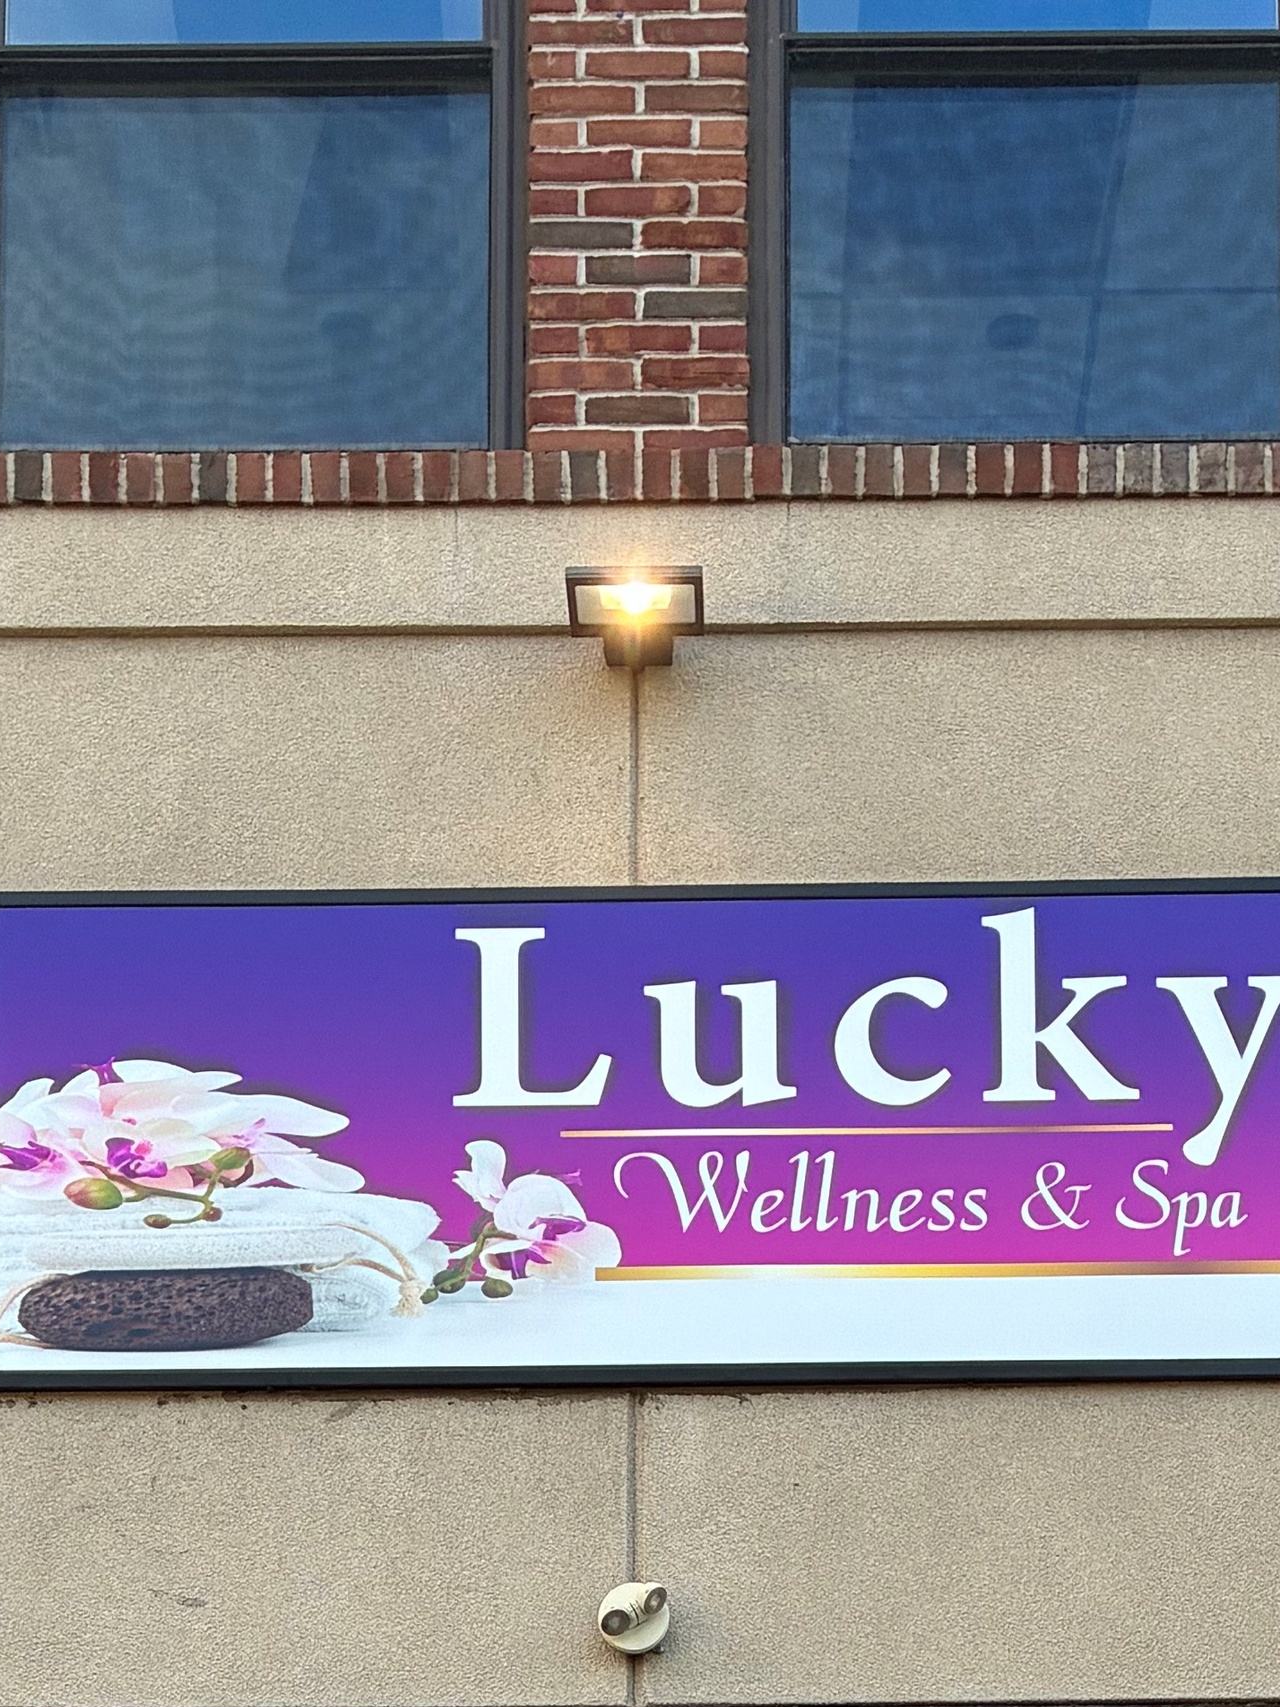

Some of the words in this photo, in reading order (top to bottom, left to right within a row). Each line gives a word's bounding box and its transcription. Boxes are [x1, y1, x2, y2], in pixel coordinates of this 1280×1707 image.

[612, 1150, 989, 1234] Wellness
[1021, 1162, 1092, 1231] &
[1115, 1159, 1249, 1257] Spa
